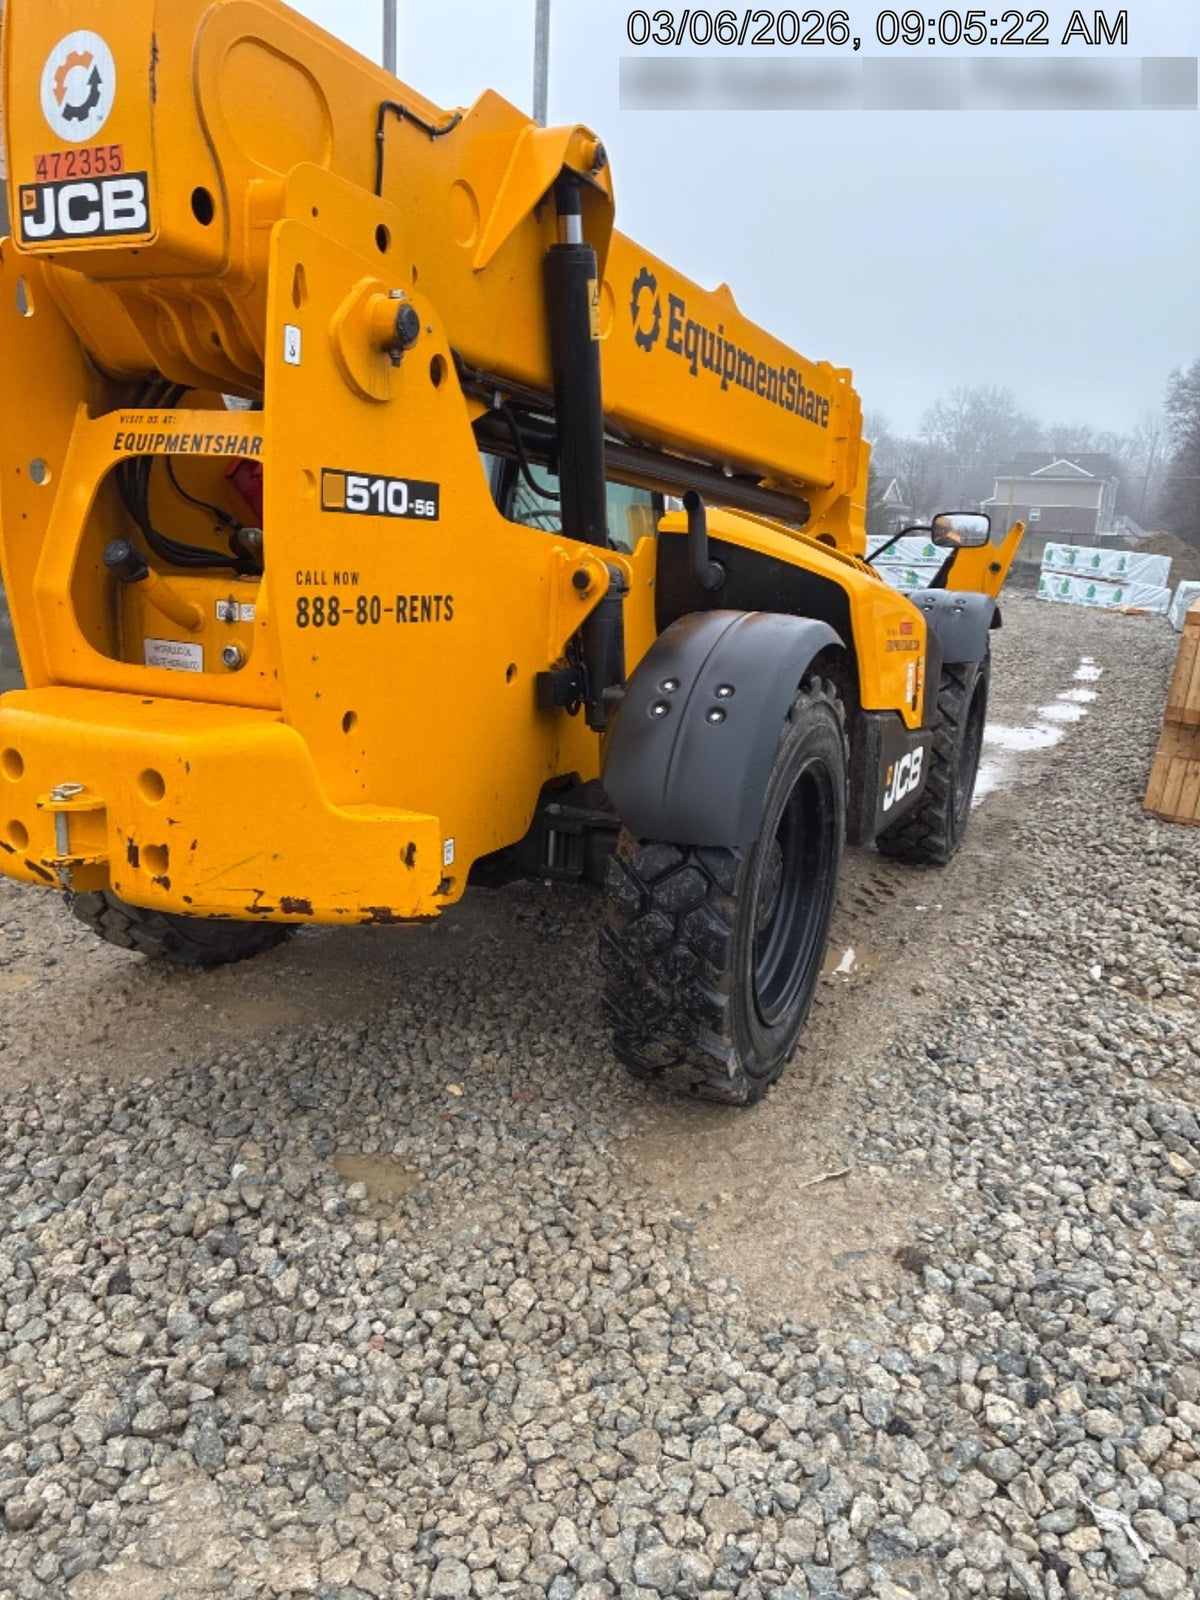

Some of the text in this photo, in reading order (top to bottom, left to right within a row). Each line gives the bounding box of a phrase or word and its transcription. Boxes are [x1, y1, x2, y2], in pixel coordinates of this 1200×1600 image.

[36, 145, 122, 180] 472355
[23, 179, 147, 237] JCB
[666, 293, 829, 428] EquipmentShare
[120, 416, 143, 424] VISIT
[113, 432, 264, 455] EQUIPMENTSHAR
[346, 475, 435, 516] 510-56
[296, 571, 360, 585] CALL NOW
[296, 595, 454, 628] 888-80-RENTS
[883, 746, 924, 811] JCB
